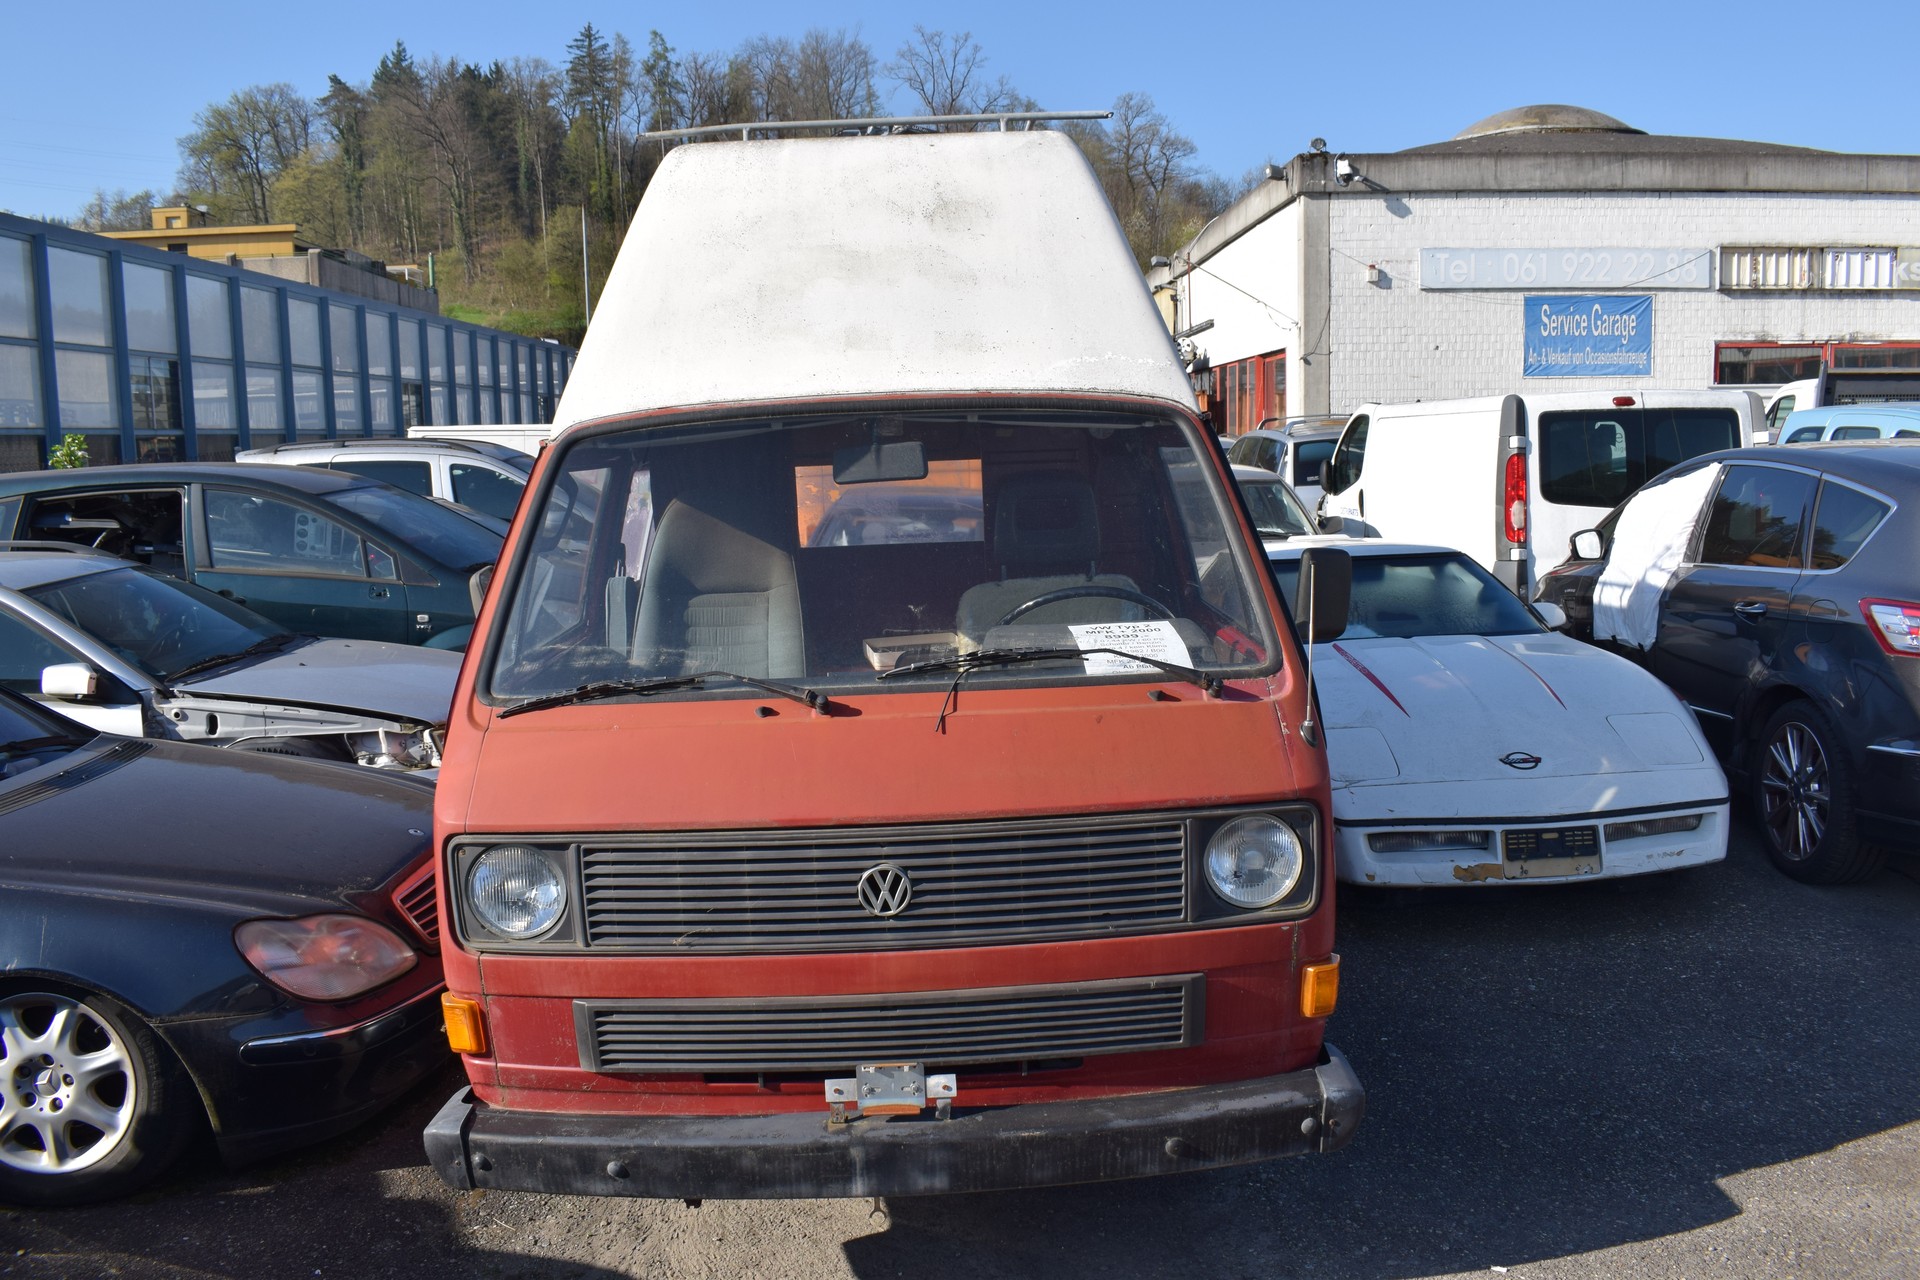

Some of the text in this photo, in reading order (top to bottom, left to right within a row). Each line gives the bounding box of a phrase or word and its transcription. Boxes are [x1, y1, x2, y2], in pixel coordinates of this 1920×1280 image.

[1437, 252, 1476, 283] Tel
[1503, 252, 1548, 283] 061
[1561, 252, 1612, 283] 922
[1622, 252, 1655, 283] 22
[1665, 252, 1697, 283] 88
[1540, 303, 1637, 345] Service Garage
[1547, 347, 1572, 365] Verkauf
[1572, 352, 1583, 365] von
[1584, 346, 1647, 369] Occasionsfahrzeuge
